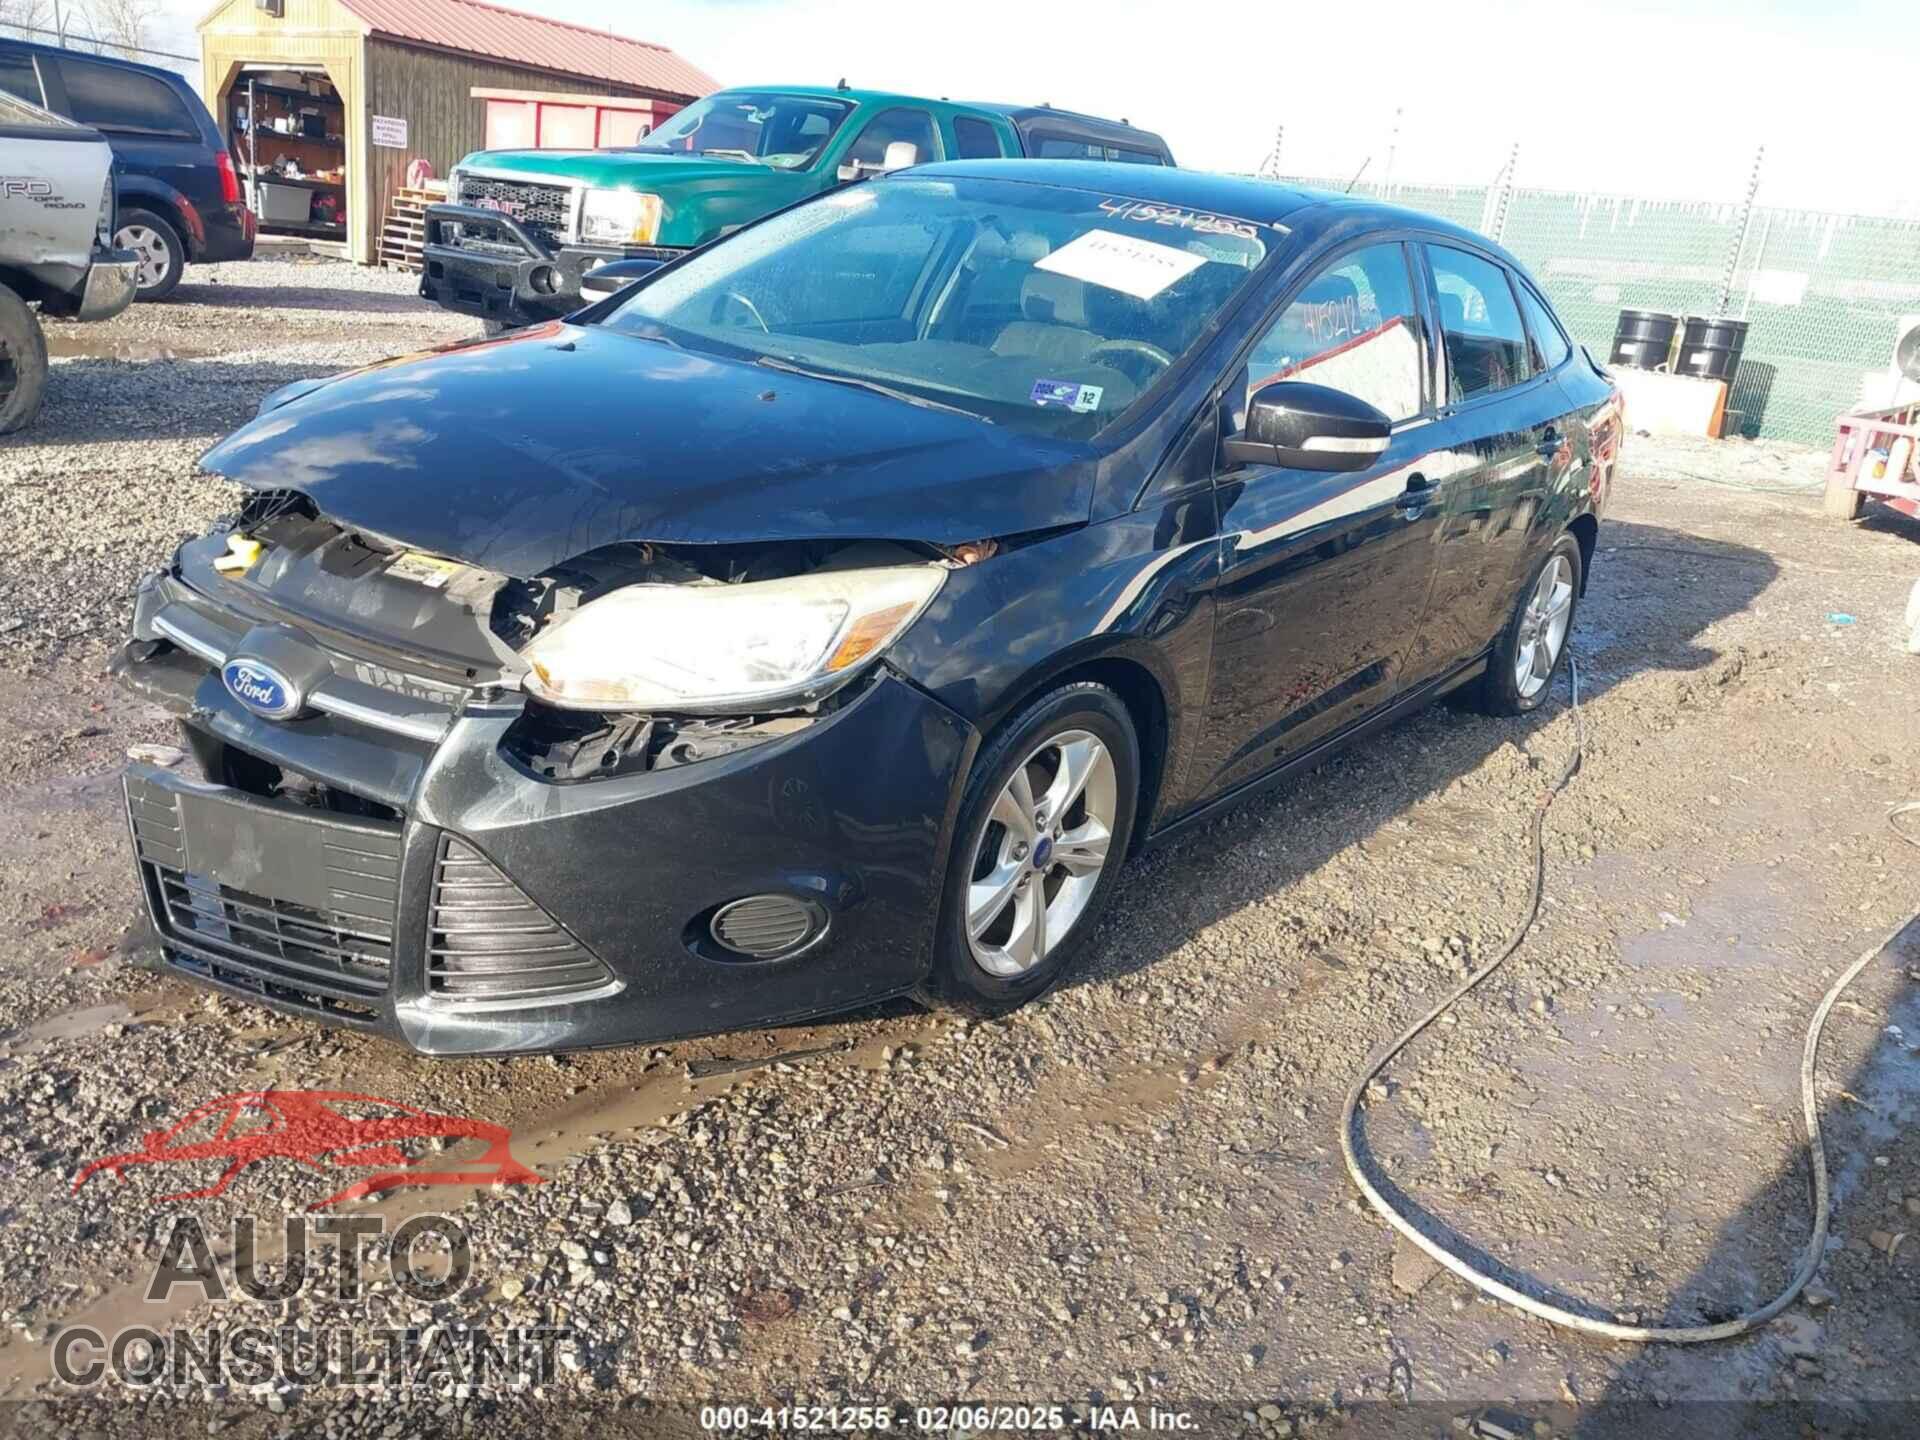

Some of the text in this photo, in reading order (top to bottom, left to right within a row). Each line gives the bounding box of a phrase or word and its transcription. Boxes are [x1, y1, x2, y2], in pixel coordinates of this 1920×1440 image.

[0, 181, 52, 199] RD
[1082, 391, 1096, 405] 12
[233, 667, 275, 704] Ford
